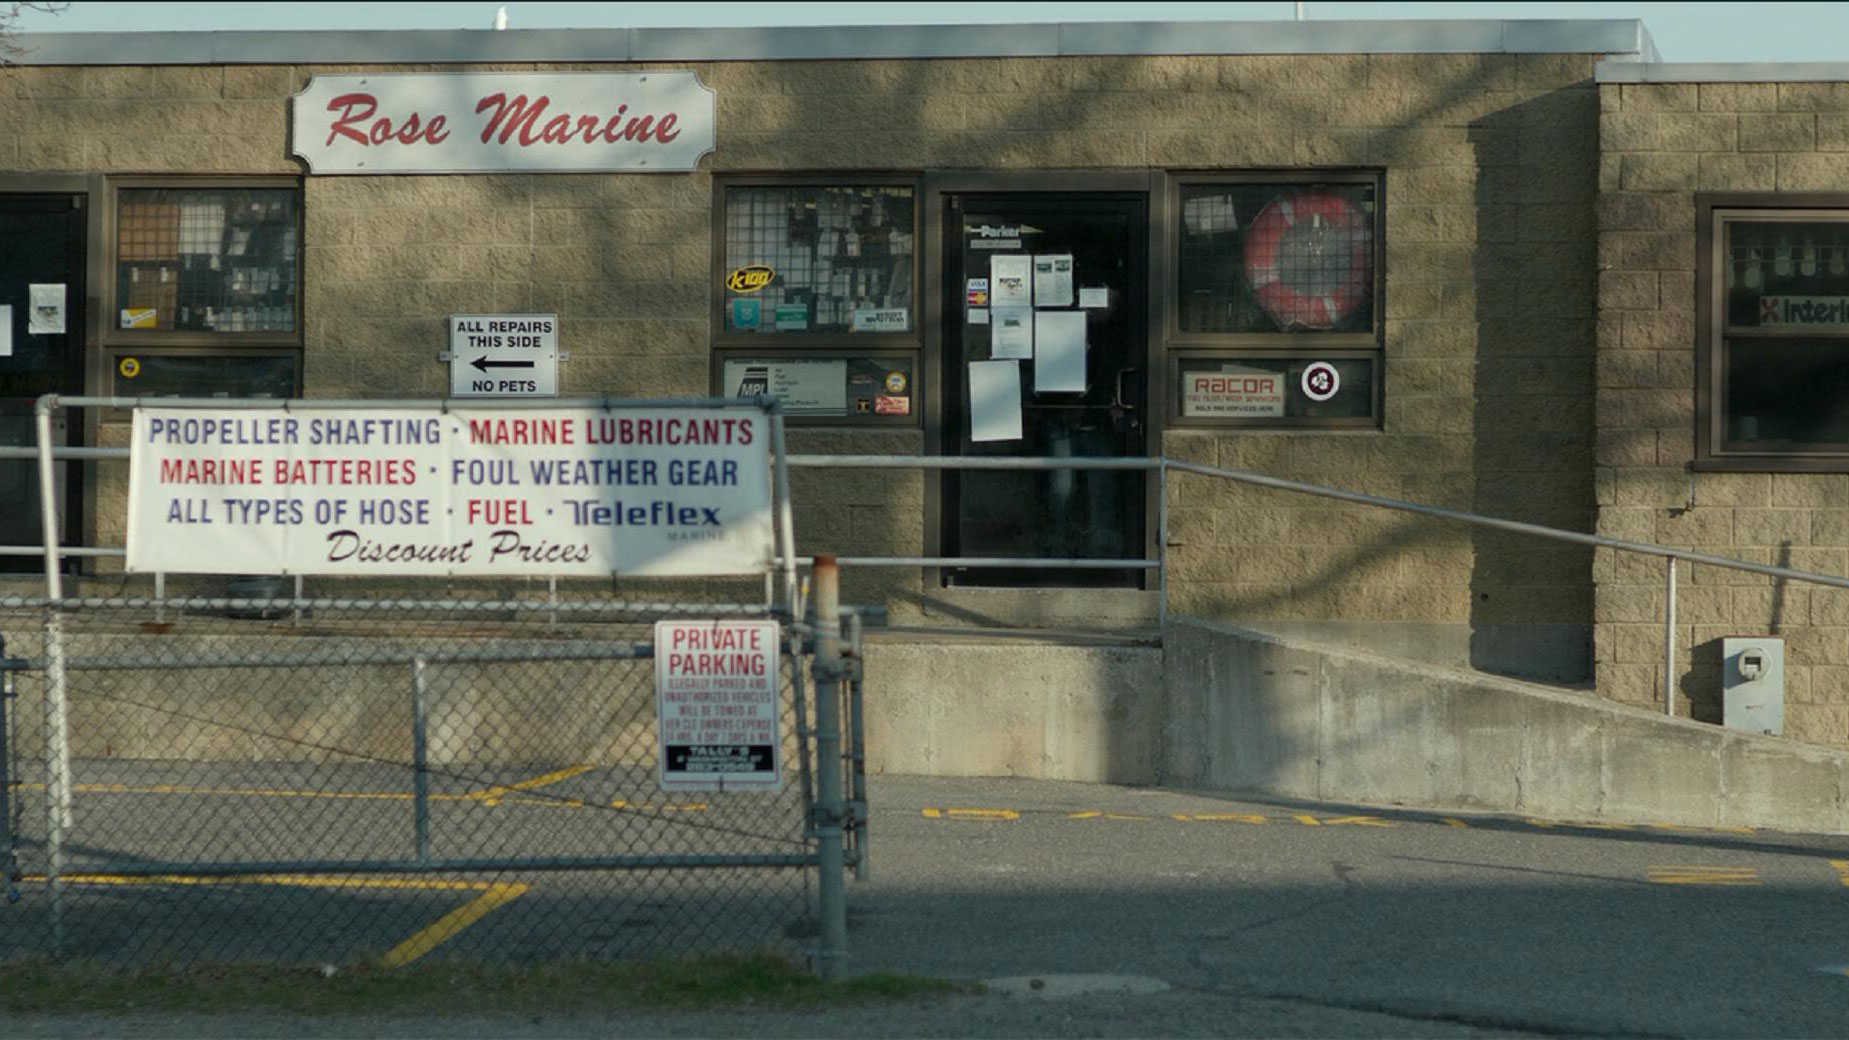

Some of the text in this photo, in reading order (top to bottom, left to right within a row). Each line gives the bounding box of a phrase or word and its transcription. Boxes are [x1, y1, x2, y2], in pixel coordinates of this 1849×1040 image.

[326, 92, 681, 147] Rose Marine
[1783, 298, 1849, 323] Interl
[457, 321, 552, 333] ALL REPAIRS
[468, 336, 542, 348] THIS SIDE
[472, 380, 537, 392] NO PETS
[150, 418, 754, 445] PROPELLER SHAFTING MARINE LUBRICANTS
[160, 459, 738, 486] MARINE BATTERIES FOUL WEATHER GEAR
[167, 498, 722, 526] ALL TYPES OF HOSE FUEL Teleflex
[326, 529, 593, 563] Discount Prices
[672, 628, 761, 651] PRIVATE
[668, 653, 766, 676] PARKING
[712, 677, 747, 689] PARKED
[749, 677, 767, 689] AND
[732, 691, 772, 704] VEHICLES
[678, 705, 758, 718] WILL BE TOWED AT
